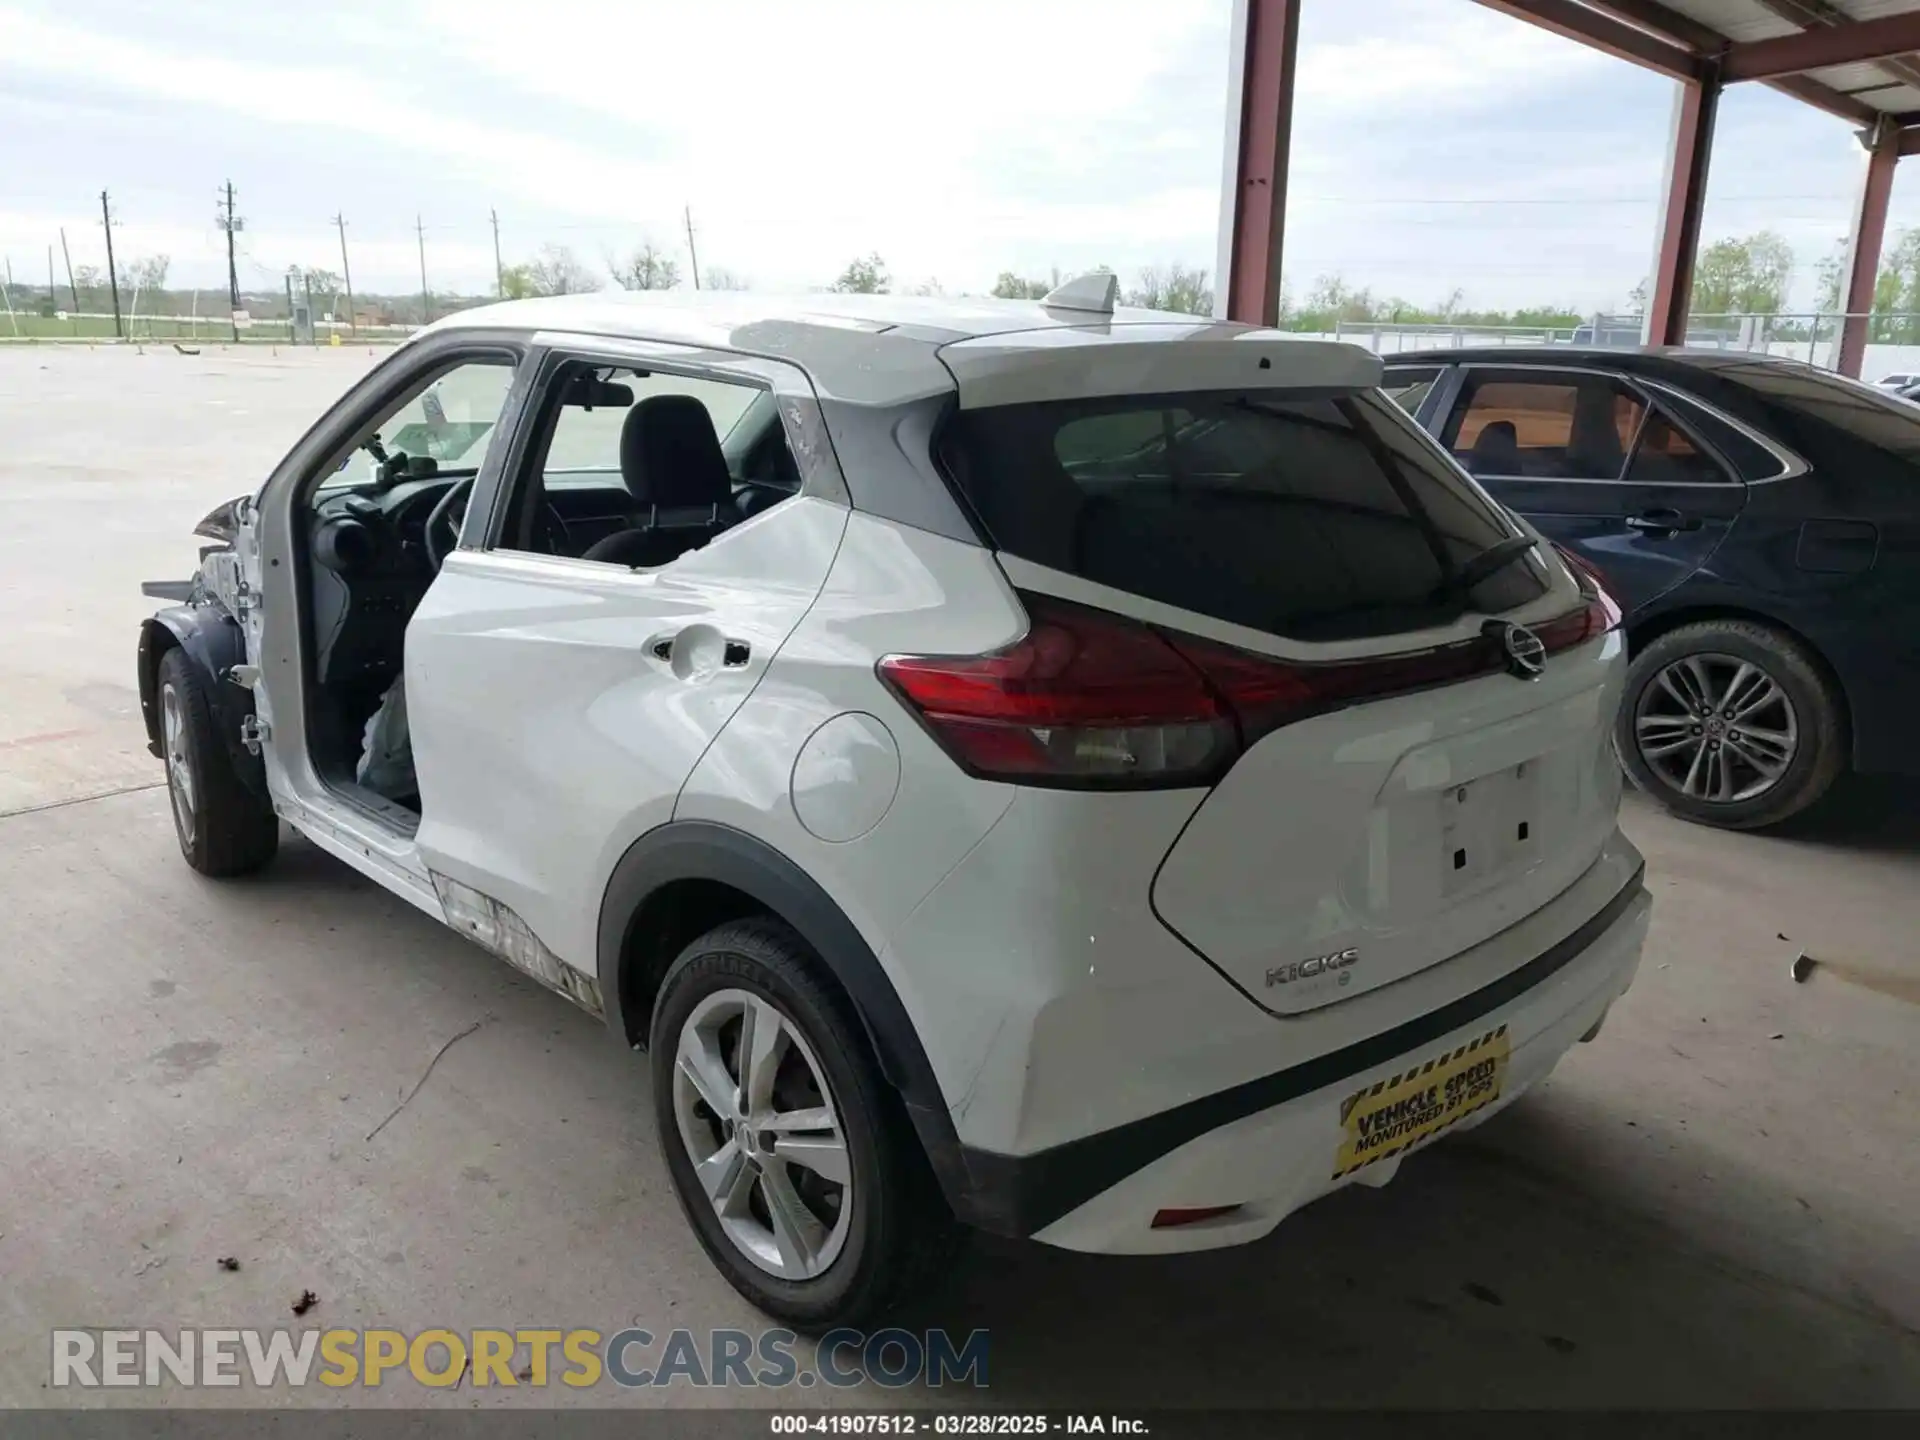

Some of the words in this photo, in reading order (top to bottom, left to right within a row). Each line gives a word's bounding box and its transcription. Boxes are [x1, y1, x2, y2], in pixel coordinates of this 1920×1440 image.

[1266, 947, 1359, 988] KICKS
[1354, 1103, 1444, 1154] MONITORED
[1467, 1076, 1493, 1100] GPS
[1357, 1085, 1439, 1137] VEHICLE
[1444, 1056, 1497, 1096] SPEED
